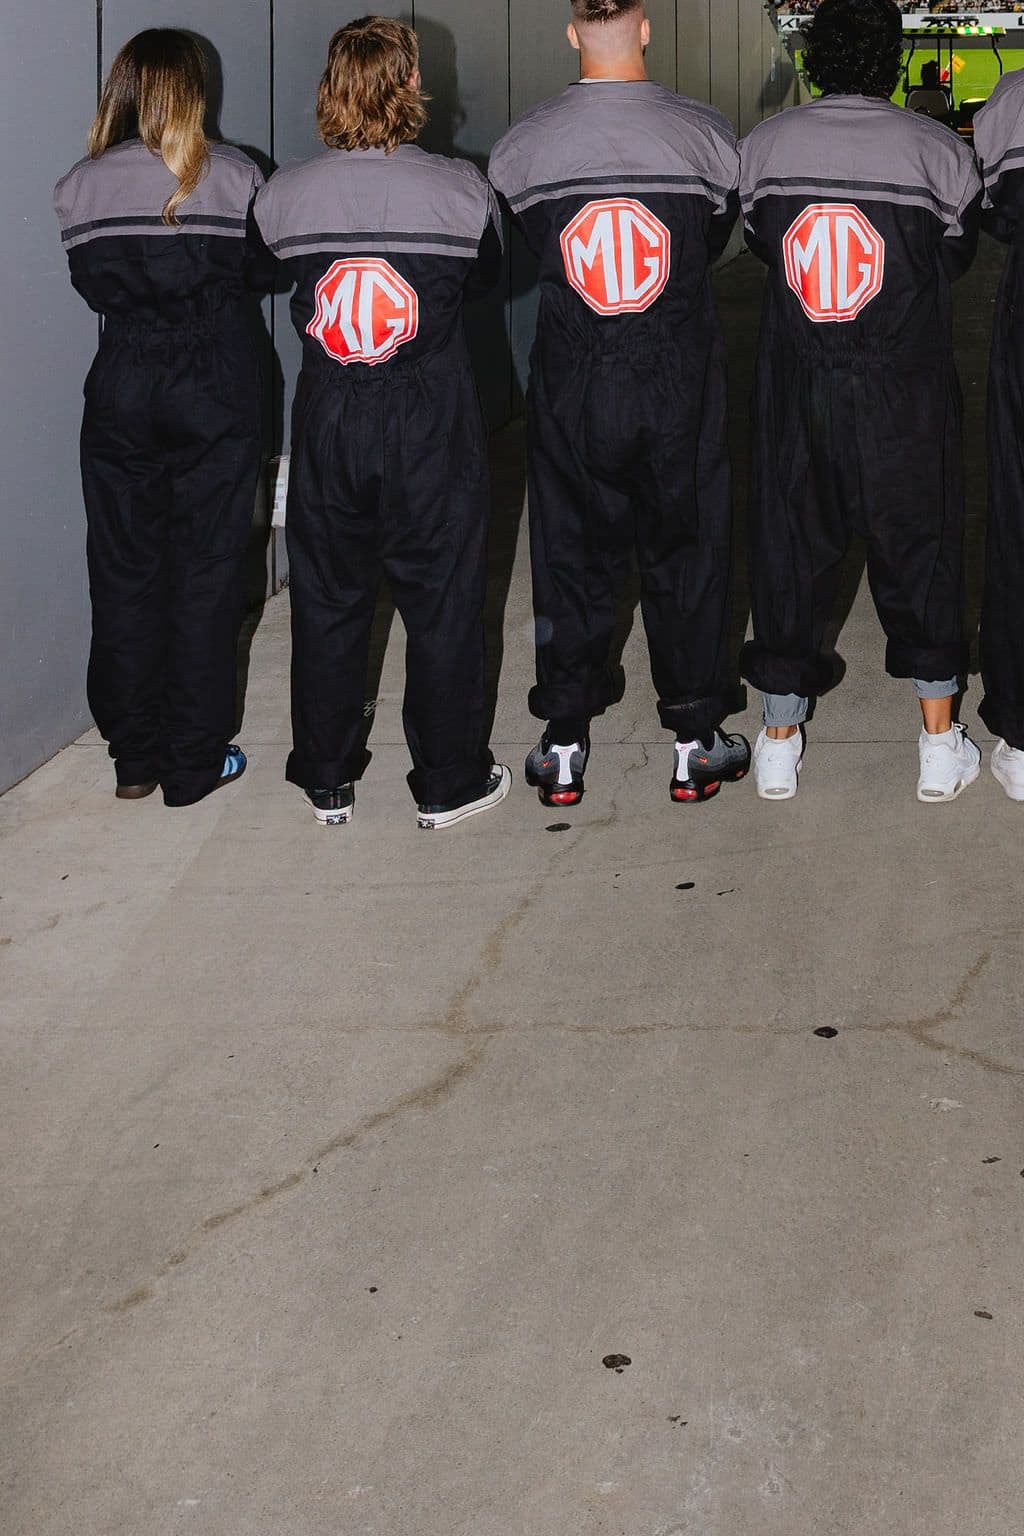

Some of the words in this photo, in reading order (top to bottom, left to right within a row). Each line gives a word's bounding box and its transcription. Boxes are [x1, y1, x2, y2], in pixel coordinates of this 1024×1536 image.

[778, 17, 801, 28] KI
[570, 210, 659, 304] MG
[793, 215, 873, 310] MG
[320, 270, 406, 357] MG
